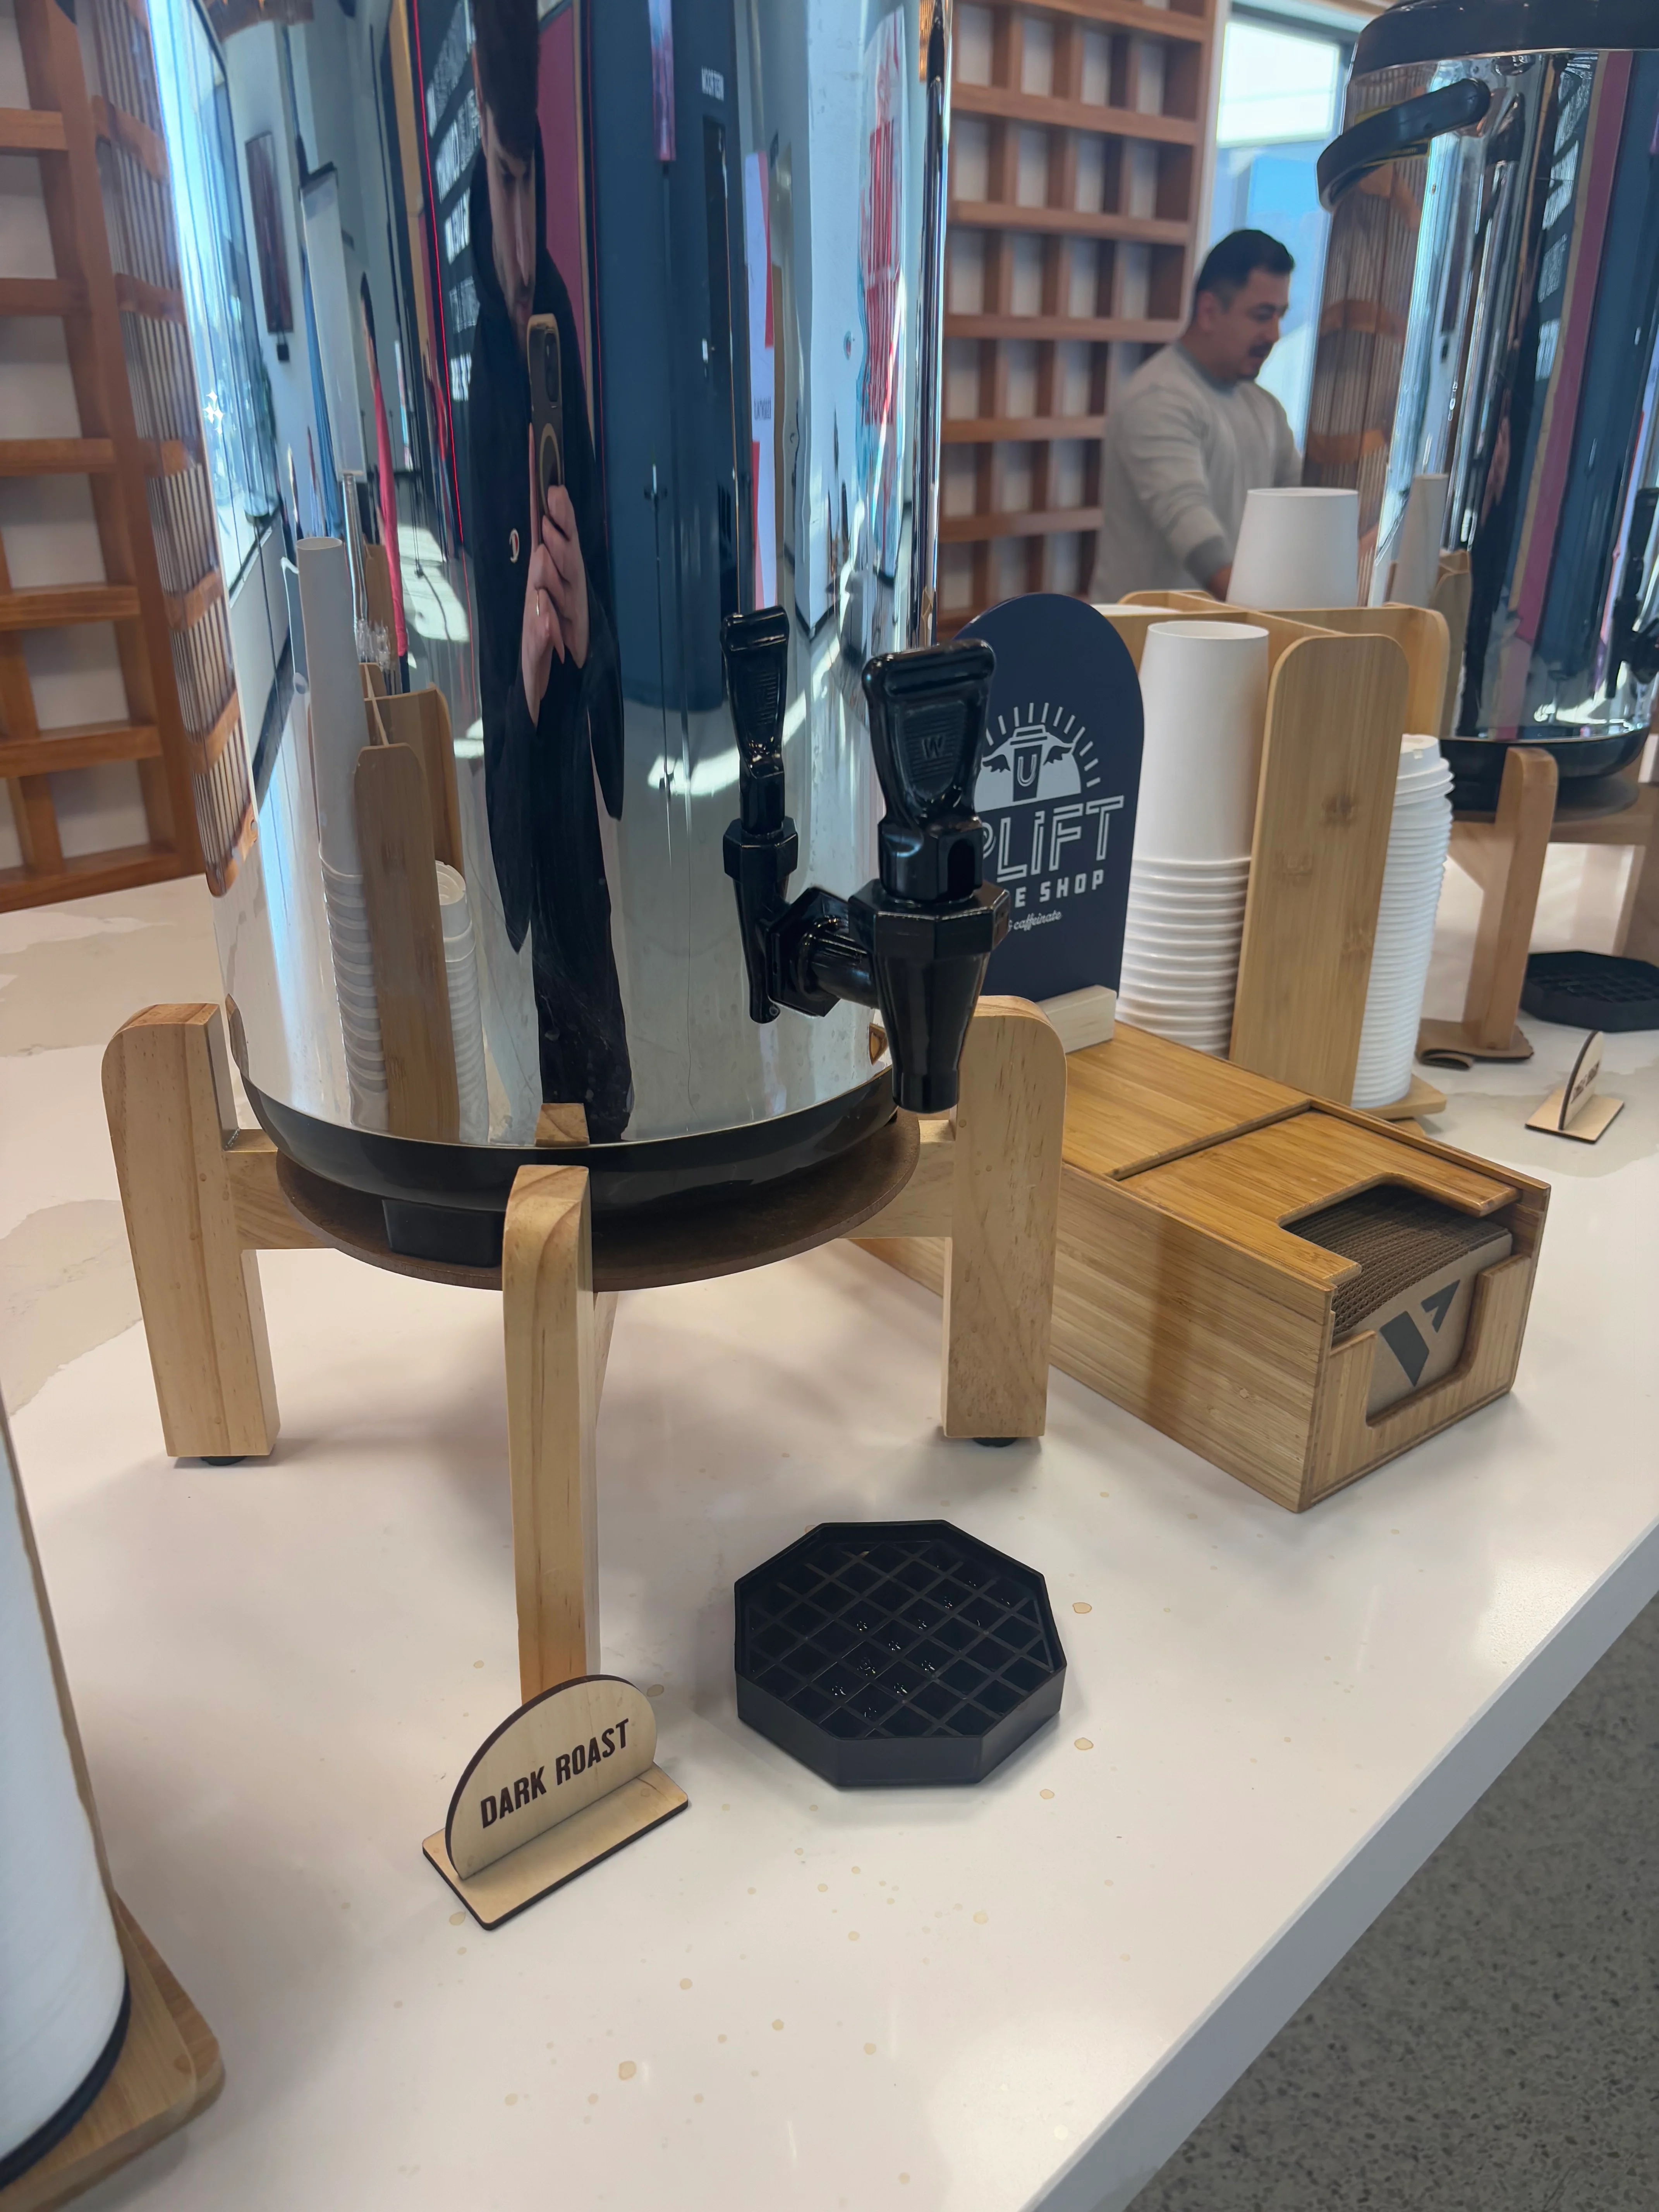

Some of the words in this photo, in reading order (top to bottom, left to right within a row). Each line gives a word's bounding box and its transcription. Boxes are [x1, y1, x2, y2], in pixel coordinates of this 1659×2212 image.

[1017, 754, 1037, 787] U
[1039, 869, 1104, 903] SHOP
[1013, 910, 1063, 931] caffeinate
[481, 1765, 547, 1829] DARK
[556, 1718, 629, 1786] ROAST
